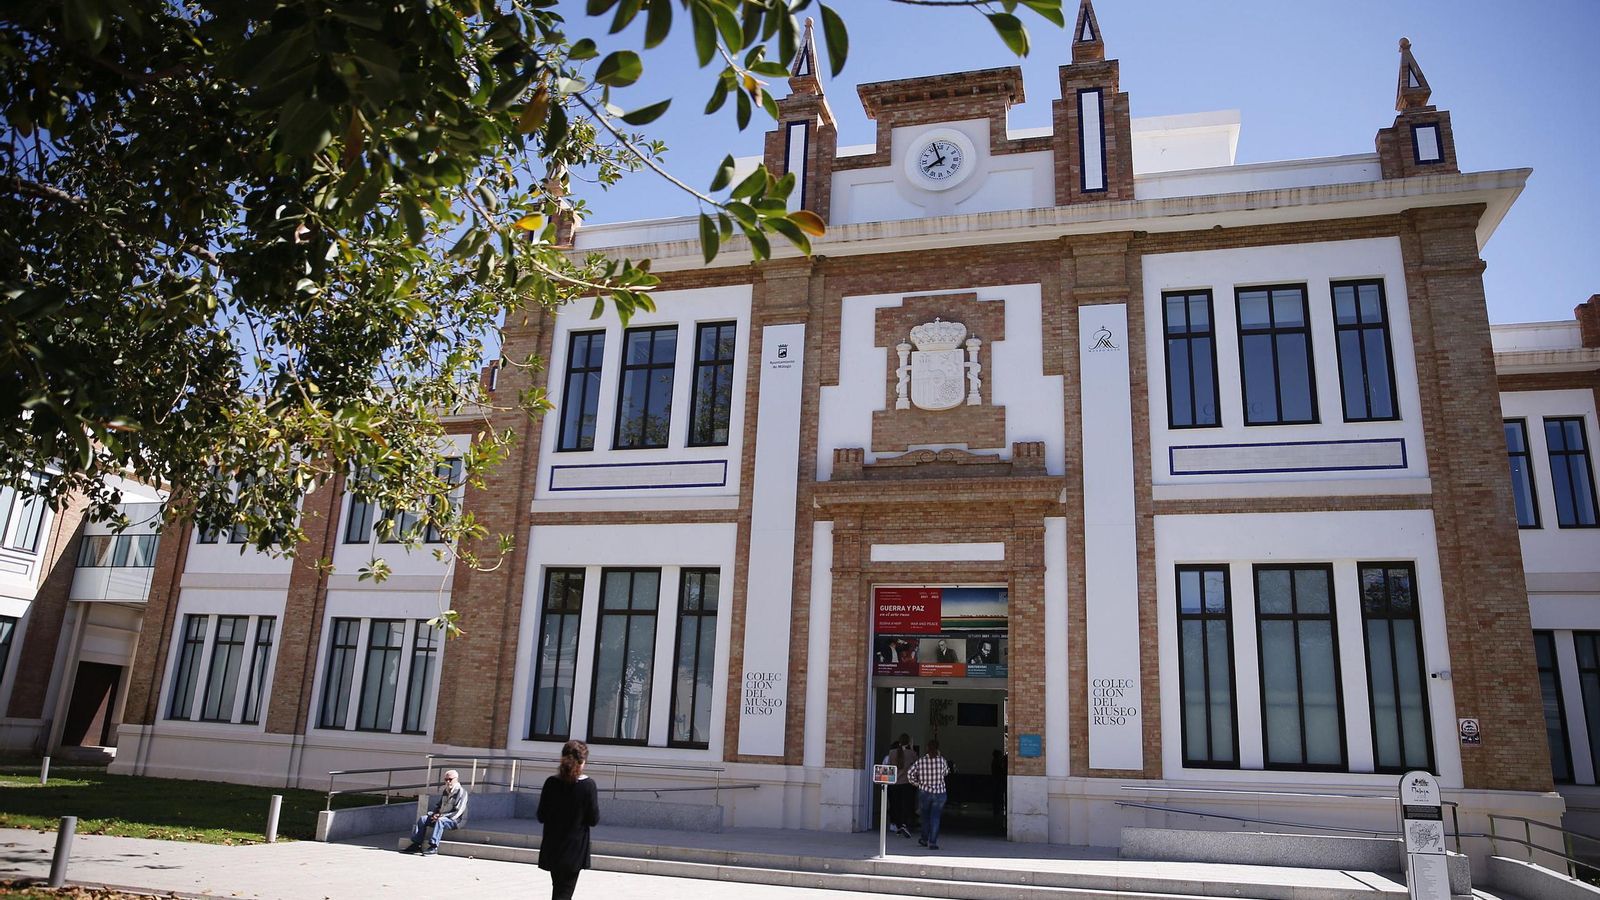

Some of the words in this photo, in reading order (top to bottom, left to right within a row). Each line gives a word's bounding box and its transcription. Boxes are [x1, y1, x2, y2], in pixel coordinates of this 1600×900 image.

[746, 671, 782, 681] COLEC
[1092, 678, 1134, 688] COLEC
[745, 689, 766, 698] DEL
[745, 698, 783, 707] MUSEO
[1093, 697, 1117, 707] DEL
[744, 706, 773, 716] RUSO
[1093, 707, 1137, 717] MUSEO
[1094, 716, 1126, 726] RUSO
